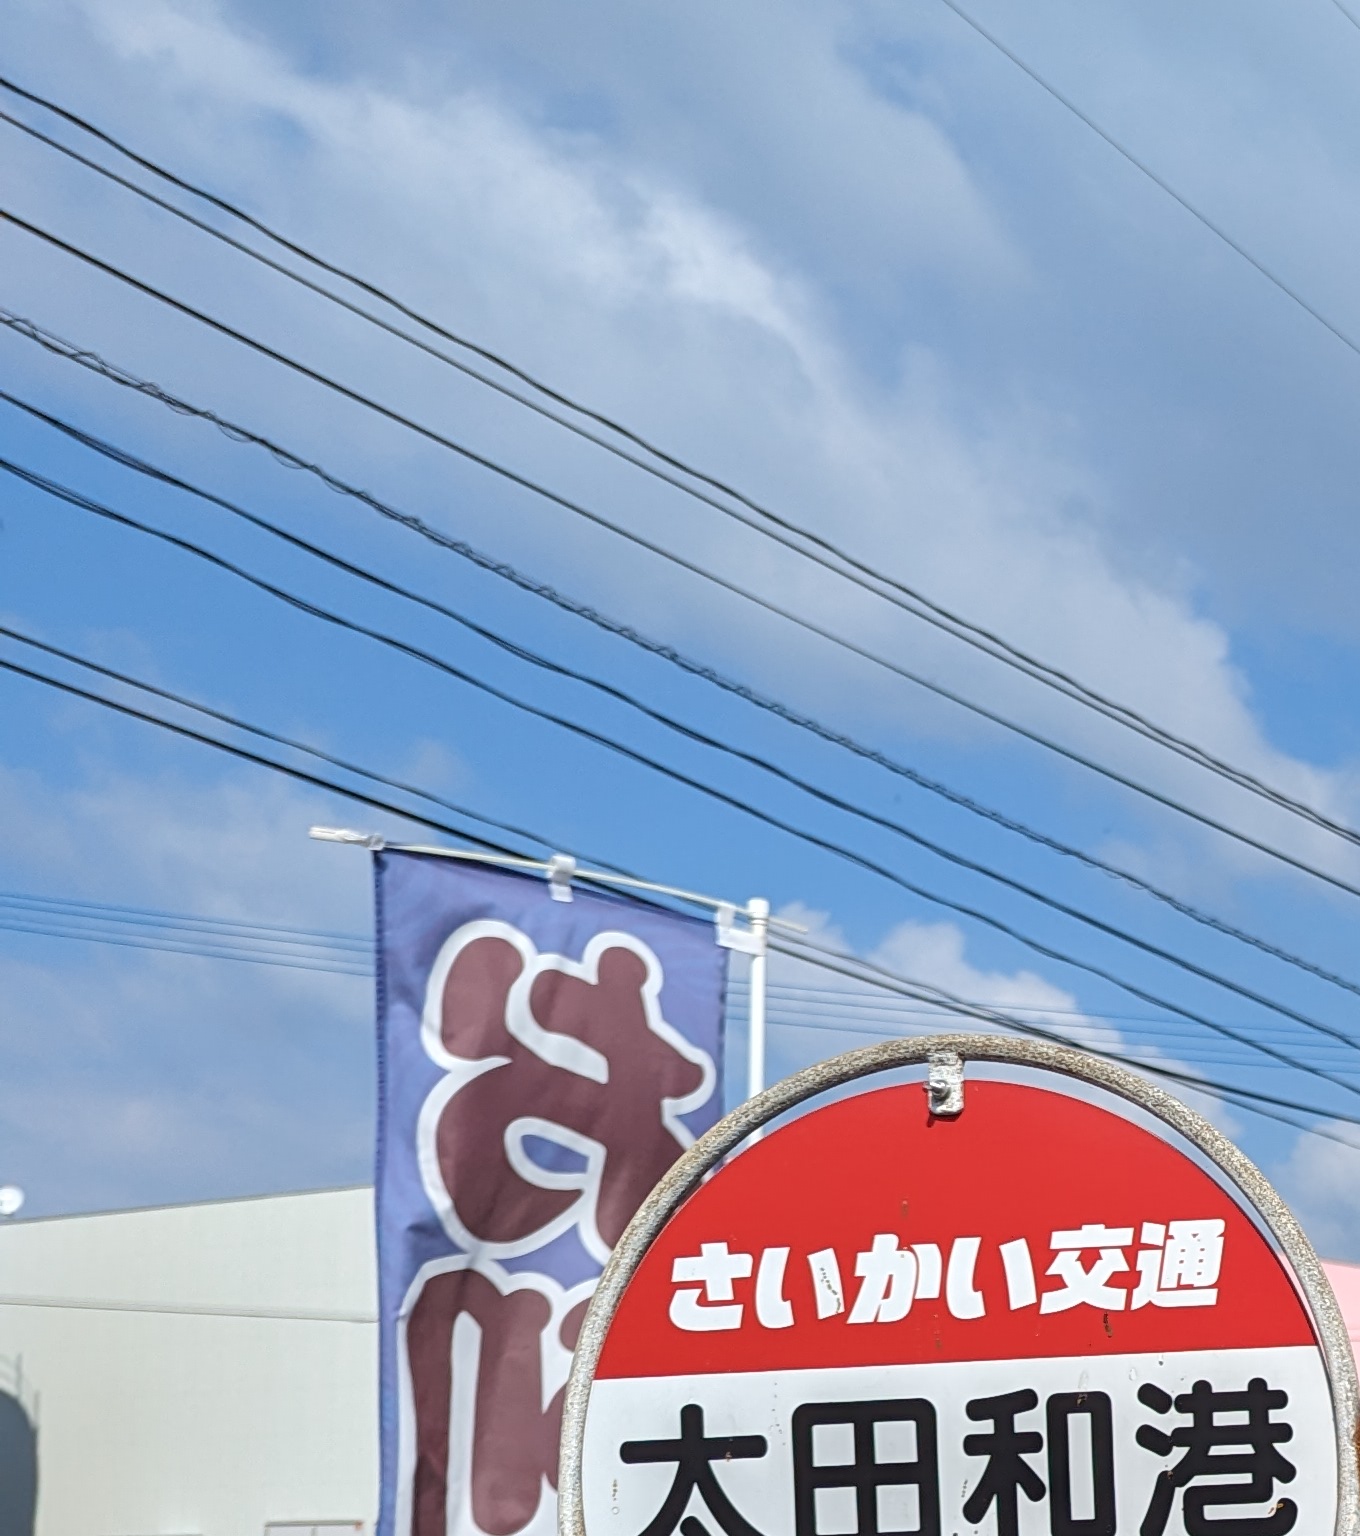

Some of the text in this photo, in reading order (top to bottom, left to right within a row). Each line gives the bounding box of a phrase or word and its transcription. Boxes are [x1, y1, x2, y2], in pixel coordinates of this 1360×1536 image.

[669, 1218, 1226, 1332] さいかい交通
